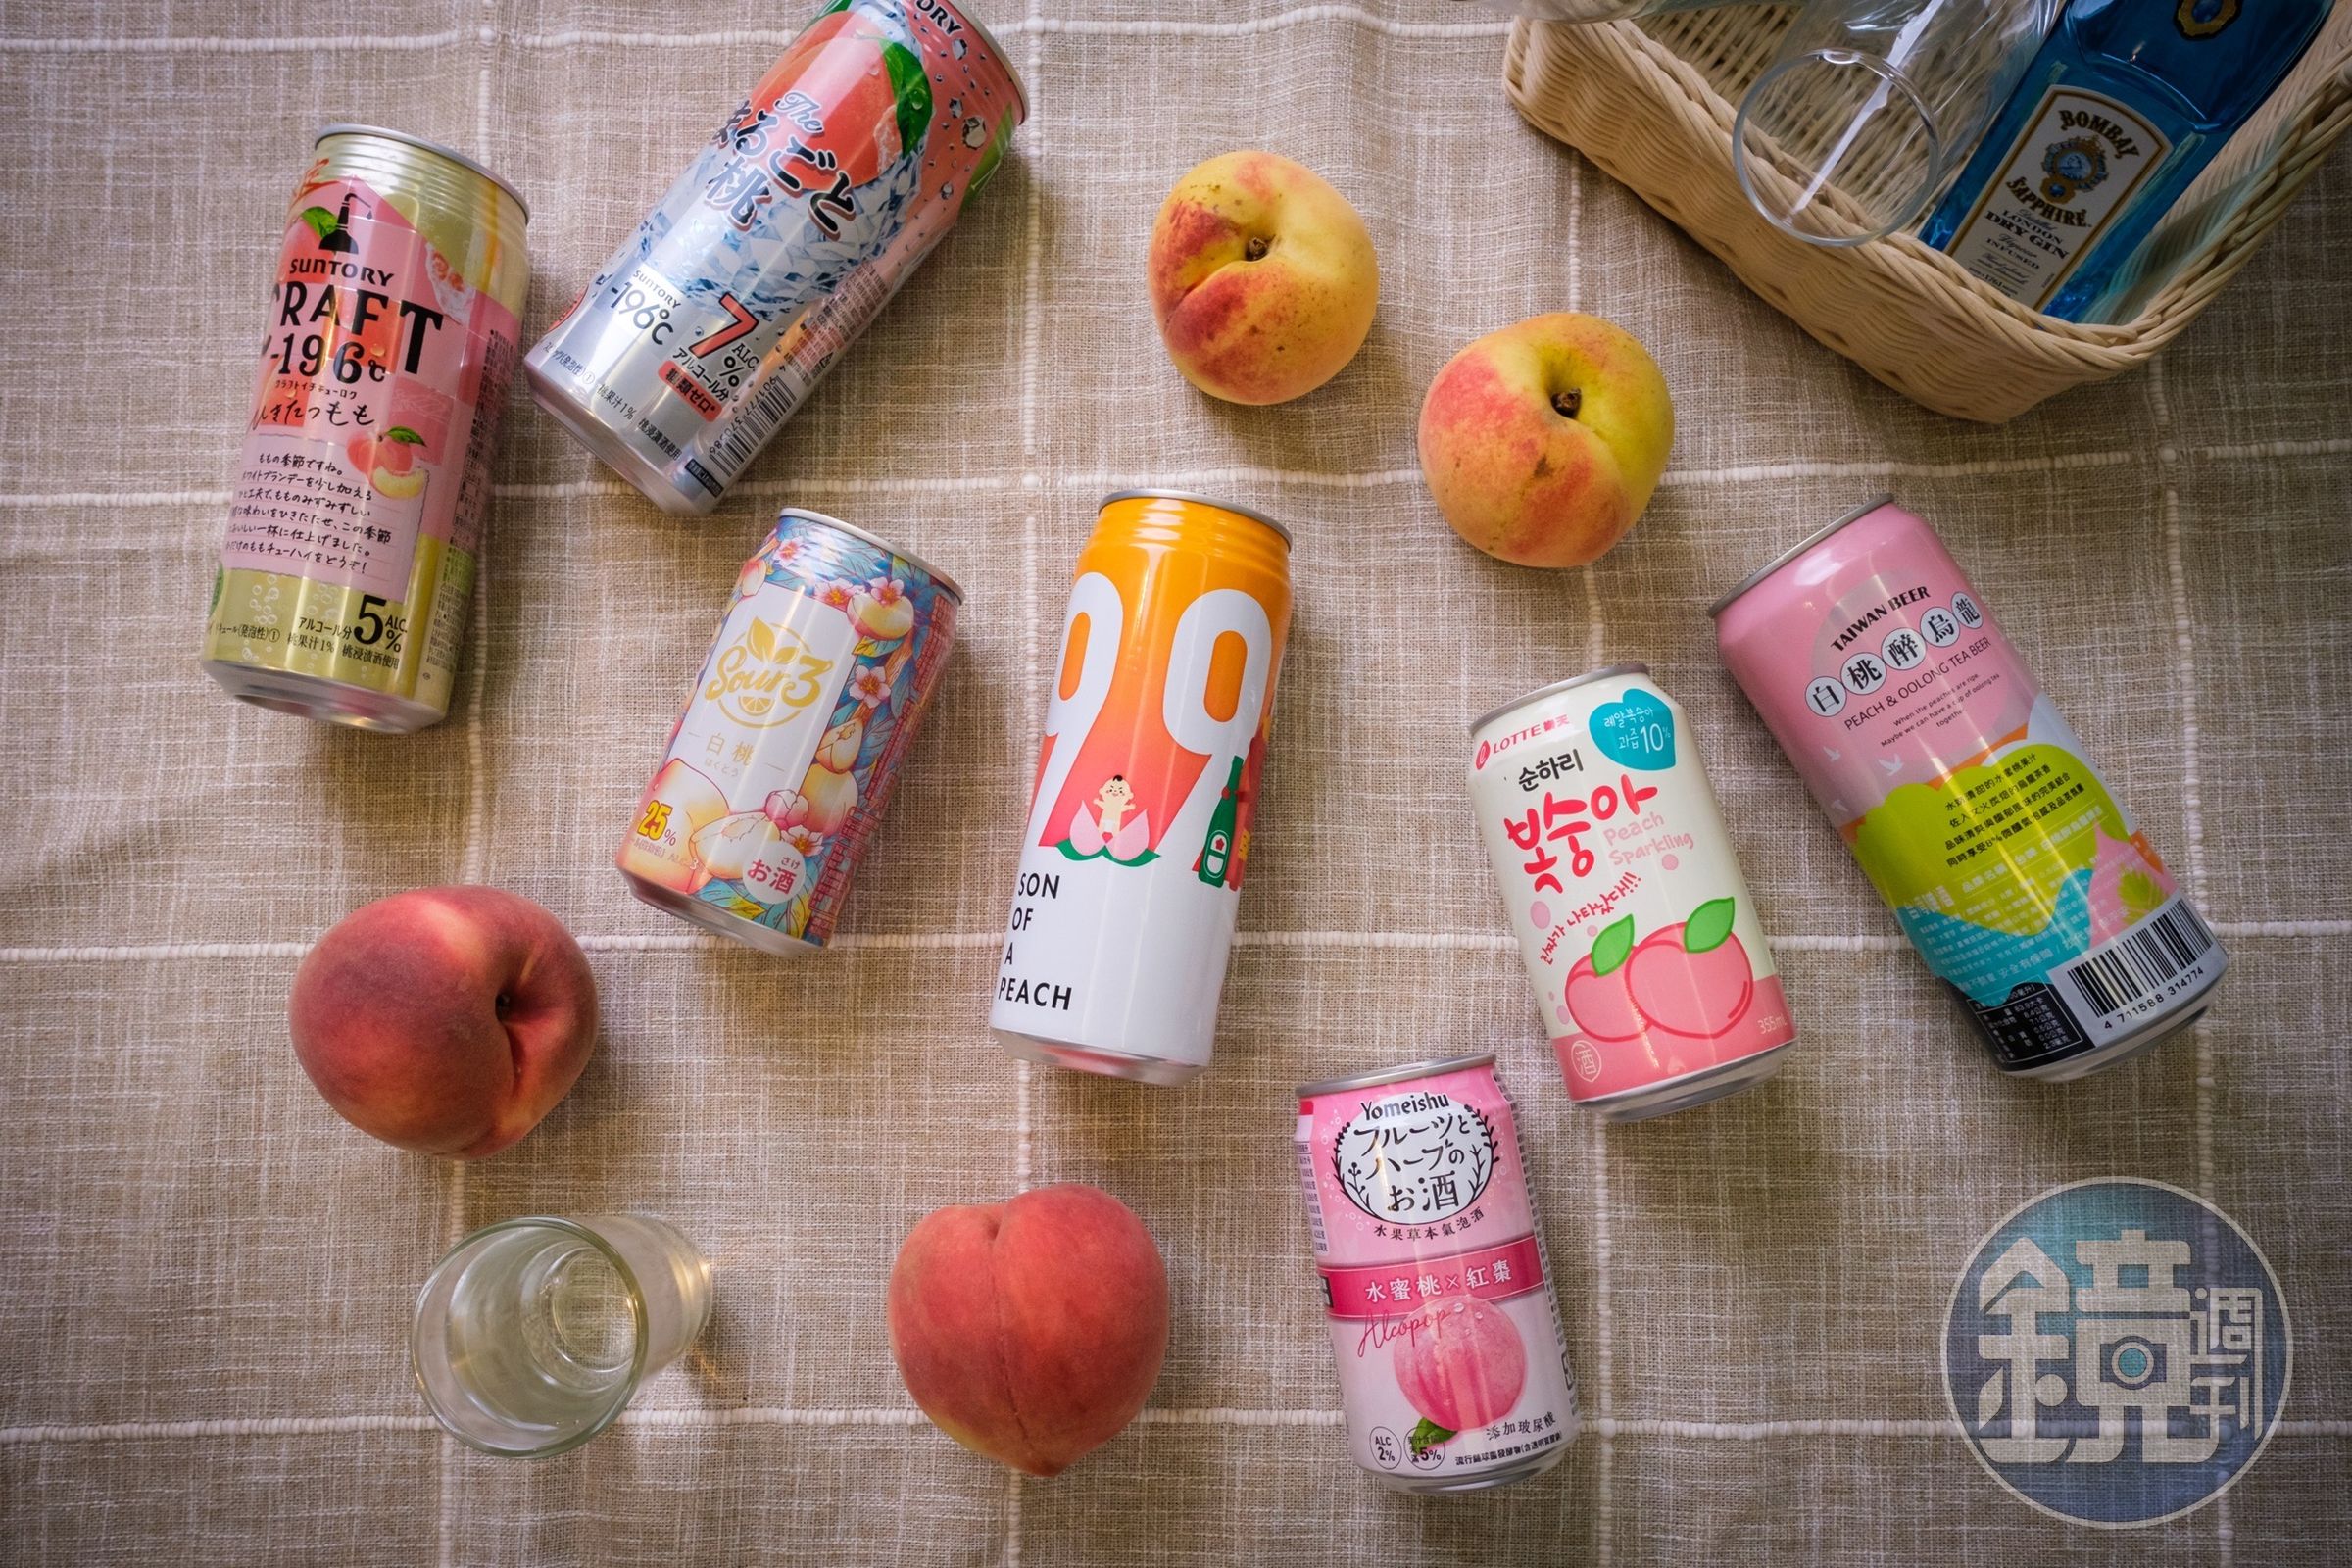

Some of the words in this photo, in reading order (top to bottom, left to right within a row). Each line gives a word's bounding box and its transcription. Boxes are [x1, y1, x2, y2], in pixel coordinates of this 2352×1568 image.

[775, 91, 823, 131] The
[2058, 109, 2140, 160] BOMBAY
[710, 100, 855, 233] まるごと
[706, 155, 771, 225] 桃
[2005, 176, 2089, 229] SAPPHIRE
[1984, 210, 2029, 237] DRY
[2029, 234, 2070, 260] GIN
[2003, 209, 2064, 245] LONDON
[1986, 237, 2040, 270] INFUSED
[289, 258, 395, 287] SUNTORY
[633, 270, 683, 310] SUNTORY
[273, 281, 444, 375] RAFT
[689, 291, 760, 359] 7
[672, 347, 730, 402] アルコール分
[259, 453, 343, 476] ももの季節ですね。
[299, 617, 351, 639] アルコール分
[1830, 604, 1888, 652] TAIWAN
[1887, 586, 1931, 612] BEER
[1812, 598, 1981, 713] 白桃醉烏龍
[1844, 701, 1886, 730] PEACH
[1886, 694, 1899, 708] &
[1898, 662, 1950, 700] OOLONG
[1948, 649, 1972, 668] TEA
[1970, 636, 1992, 658] BEER
[1880, 729, 1904, 748] Maybe
[1904, 724, 1916, 734] we
[1915, 716, 1930, 728] can
[1929, 707, 1947, 720] have
[1893, 711, 1915, 727] When
[1915, 704, 1928, 714] the
[706, 732, 754, 766] 白桃
[1494, 724, 1542, 754] LOTTE
[1617, 727, 1641, 751] 과즙
[1518, 748, 1584, 792] 순하리
[1503, 773, 1659, 894] 복숭아
[1603, 811, 1665, 846] Peach
[781, 856, 801, 870] さけ
[1608, 830, 1695, 868] Sparkling
[747, 858, 797, 895] お酒
[1017, 872, 1061, 900] SON
[1011, 906, 1034, 931] OF
[1004, 948, 1014, 966] A
[998, 977, 1073, 1011] PEACH
[2103, 1020, 2113, 1031] 4
[2117, 994, 2165, 1023] 711588
[2169, 966, 2204, 997] 314774
[1575, 1045, 1599, 1073] 酒
[1360, 1091, 1450, 1123] Yomeishu
[1353, 1111, 1470, 1157] フルーツと
[1365, 1138, 1465, 1181] ハーブの
[1387, 1169, 1460, 1212] お酒
[1374, 1206, 1485, 1241] 水果草本氣泡酒
[1357, 1306, 1453, 1358] Alcopop
[1375, 1436, 1392, 1446] ALC
[1486, 1411, 1556, 1441] 添加玻尿酸
[1377, 1446, 1396, 1462] 2%
